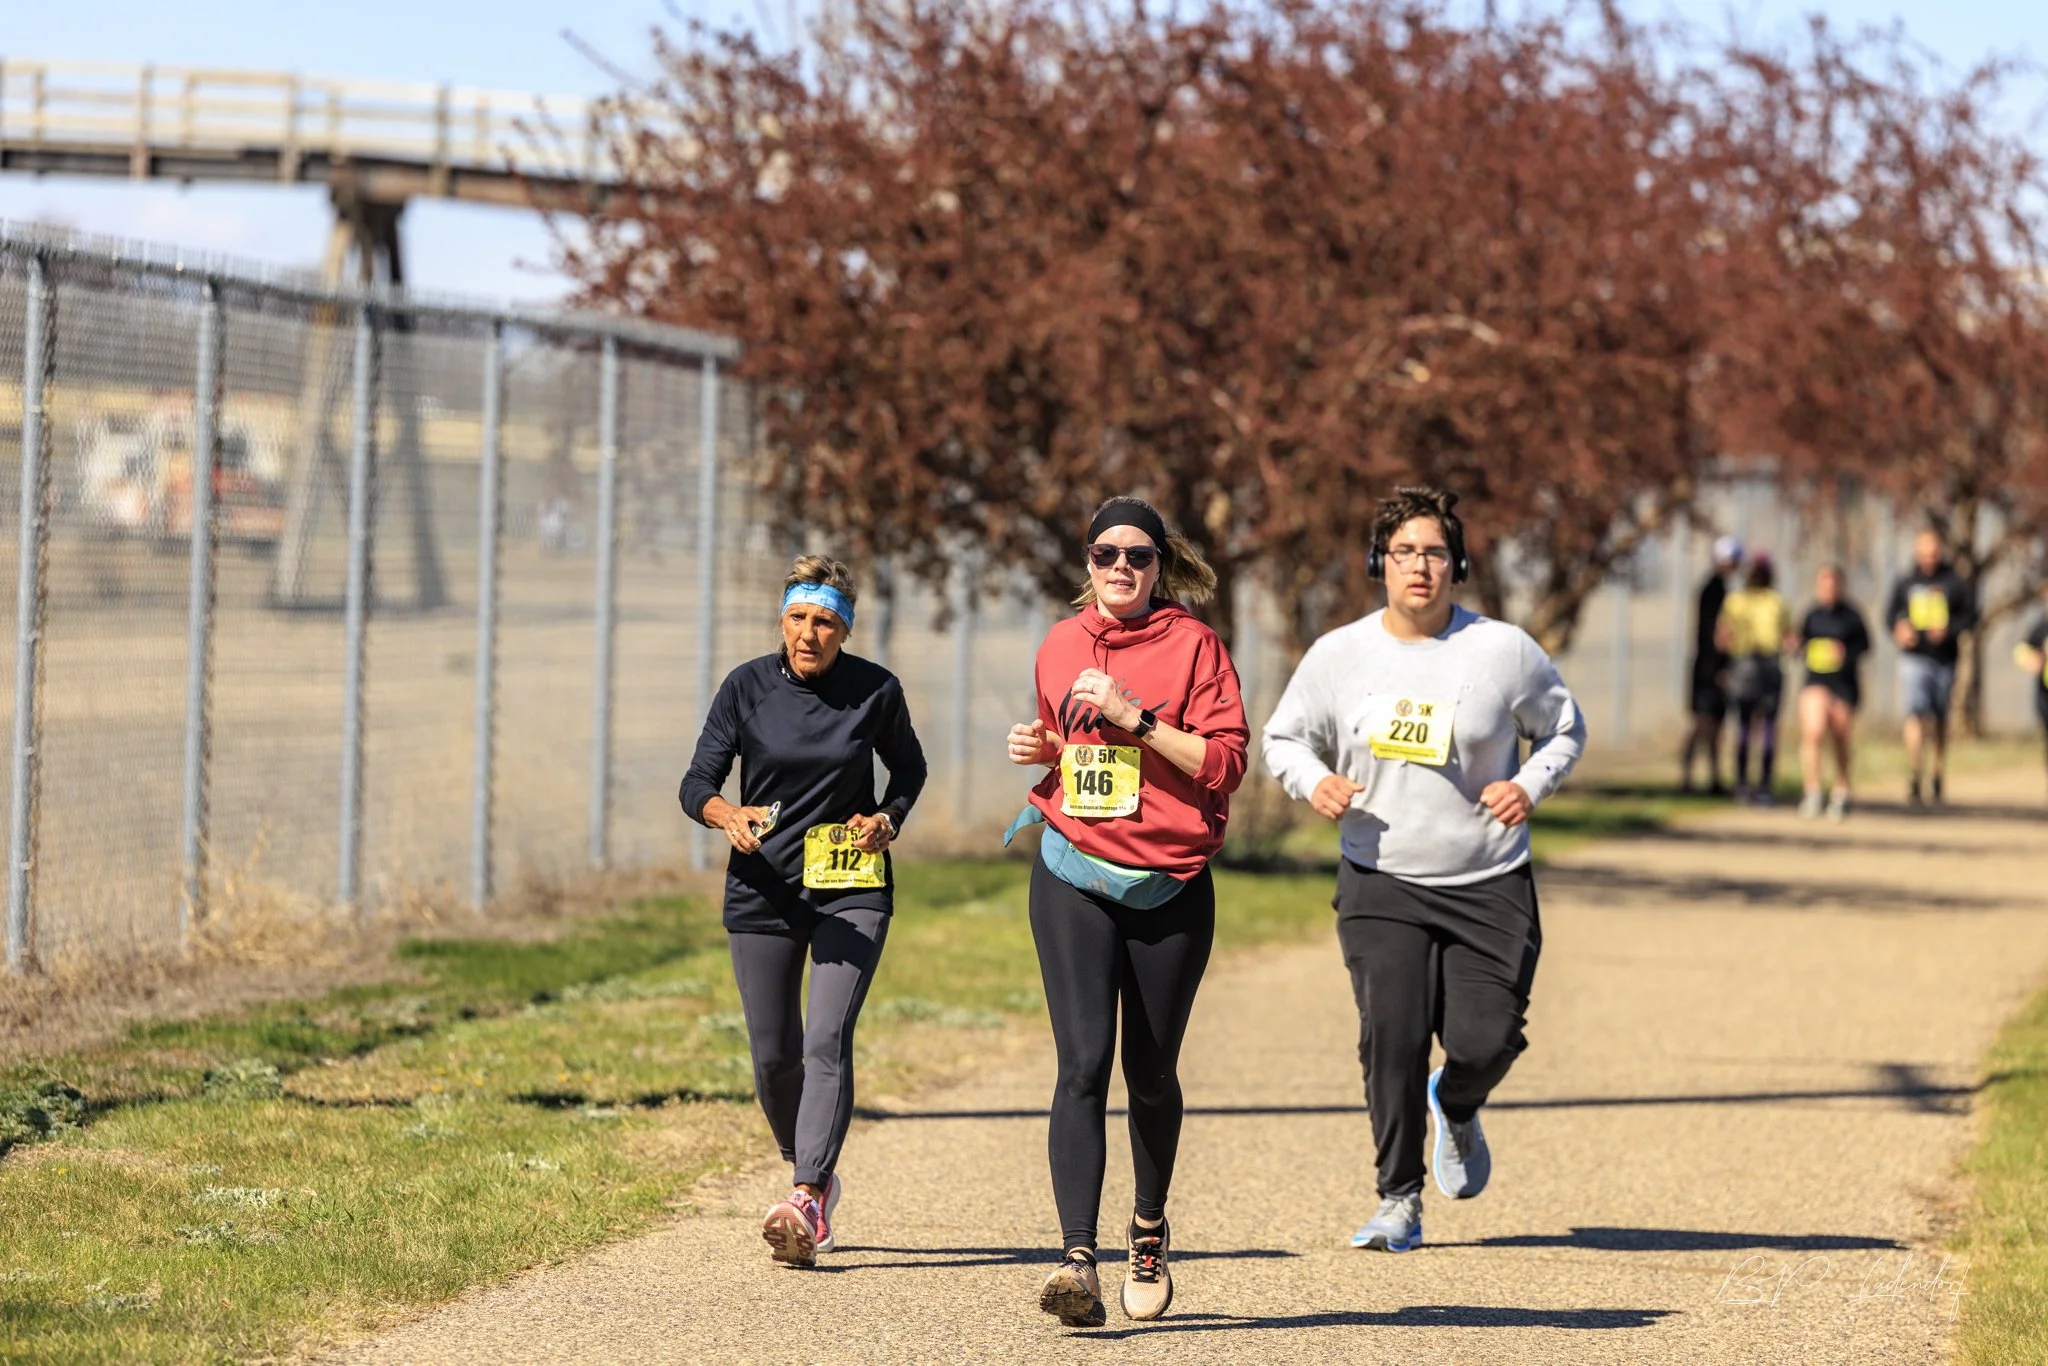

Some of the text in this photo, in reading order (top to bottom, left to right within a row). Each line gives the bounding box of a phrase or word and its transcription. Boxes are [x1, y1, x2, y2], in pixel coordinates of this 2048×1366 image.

[1418, 704, 1433, 717] 5K
[1388, 719, 1429, 744] 220
[1098, 748, 1117, 764] 5K
[1073, 769, 1114, 796] 146
[829, 848, 863, 871] 112
